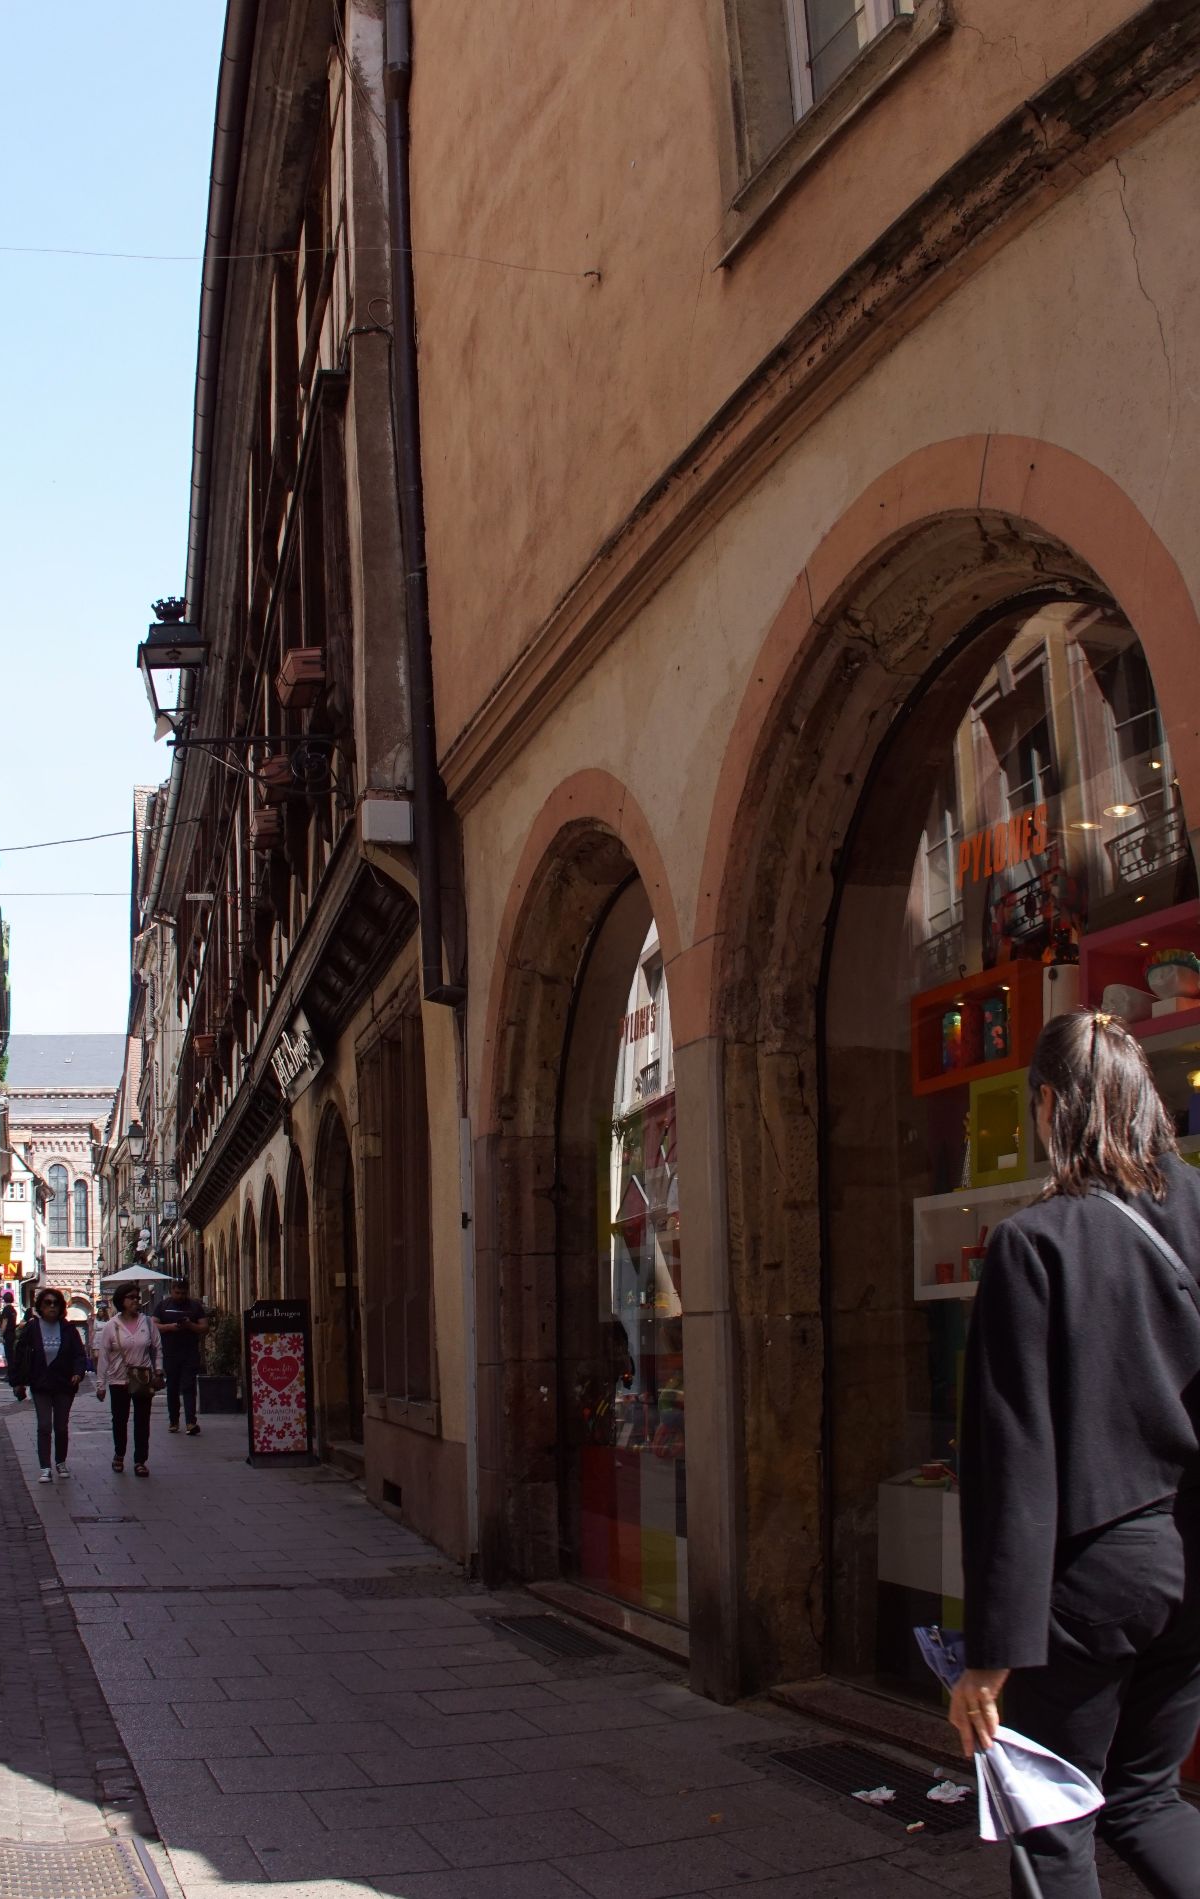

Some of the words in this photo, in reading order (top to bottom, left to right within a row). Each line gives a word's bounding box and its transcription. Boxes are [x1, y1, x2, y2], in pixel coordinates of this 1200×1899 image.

[955, 803, 1048, 891] PYLONES
[617, 1002, 657, 1046] PYLONES
[7, 1262, 18, 1274] N
[251, 1310, 265, 1318] Jeff
[274, 1308, 301, 1319] Bruges
